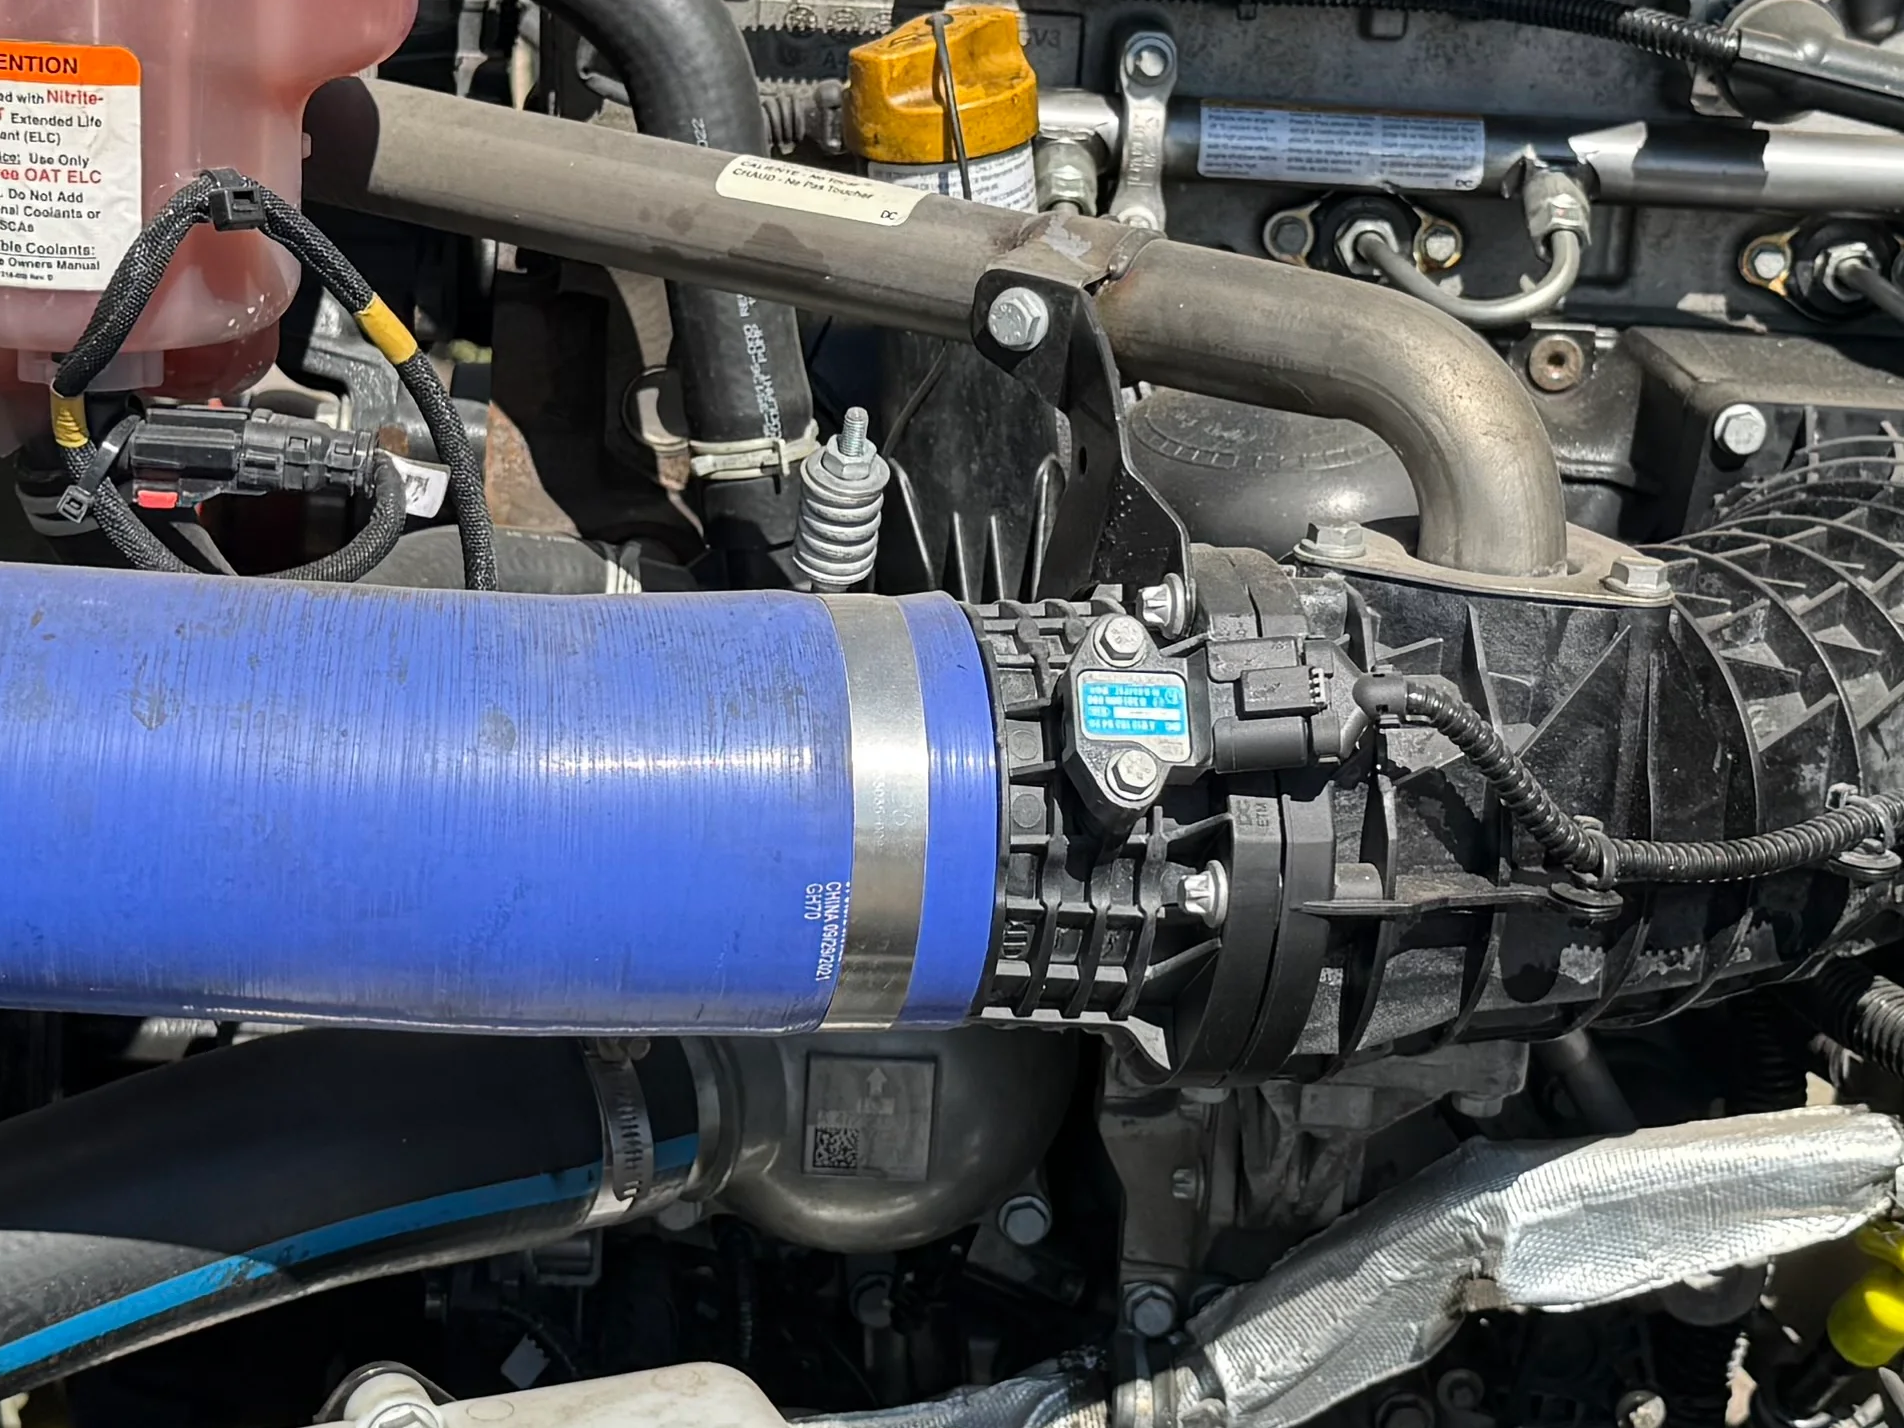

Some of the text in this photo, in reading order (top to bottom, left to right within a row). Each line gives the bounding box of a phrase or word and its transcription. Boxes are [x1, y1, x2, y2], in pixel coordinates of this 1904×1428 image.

[17, 92, 44, 104] with
[47, 90, 104, 105] Nitrite-
[11, 113, 73, 127] Extended
[77, 115, 102, 128] Life
[24, 129, 61, 146] (ELC)
[29, 153, 54, 165] Use
[58, 155, 90, 169] Only
[24, 169, 62, 183] OAT
[67, 170, 102, 184] ELC
[733, 168, 775, 183] CHAUD
[805, 181, 824, 192] Pas
[827, 184, 874, 201] Toucher
[8, 188, 26, 200] Do
[29, 190, 53, 202] Not
[57, 190, 84, 203] Add
[23, 207, 83, 220] Coolants
[87, 209, 101, 219] or
[880, 210, 898, 220] DC
[0, 220, 34, 233] SCAs
[26, 242, 95, 257] Coolants:
[8, 257, 54, 270] Owners
[57, 260, 100, 271] Manual
[804, 883, 823, 920] GH70
[824, 881, 842, 922] CHINA
